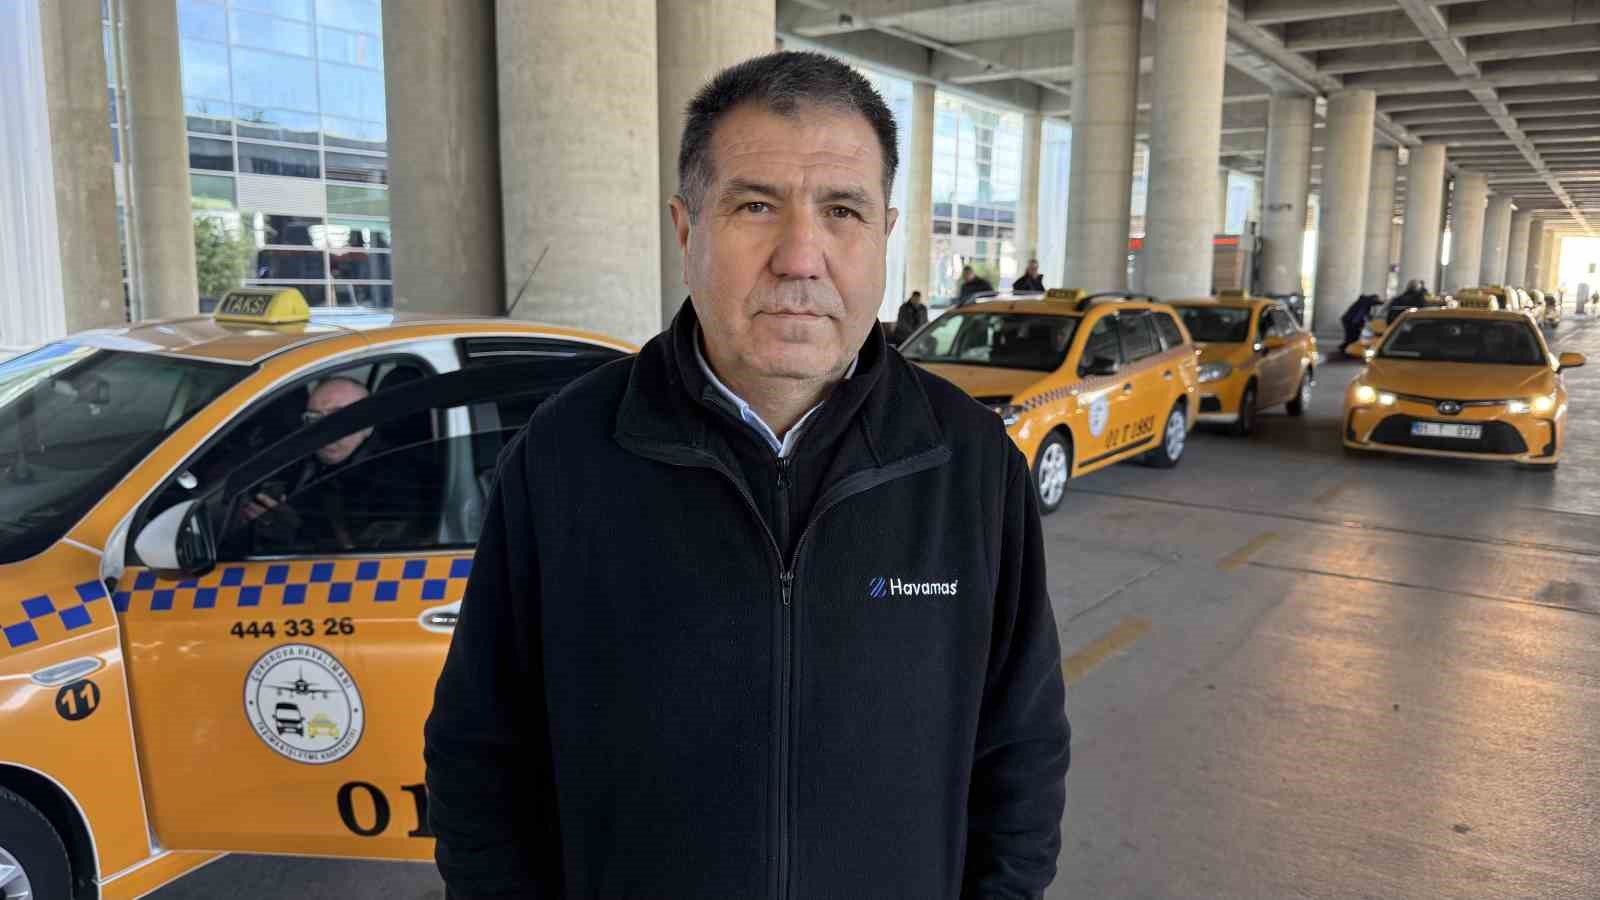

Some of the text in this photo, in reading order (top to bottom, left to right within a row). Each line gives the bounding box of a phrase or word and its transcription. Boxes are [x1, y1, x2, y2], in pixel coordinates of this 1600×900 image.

[230, 617, 355, 638] 444 33 26
[62, 683, 96, 715] 11
